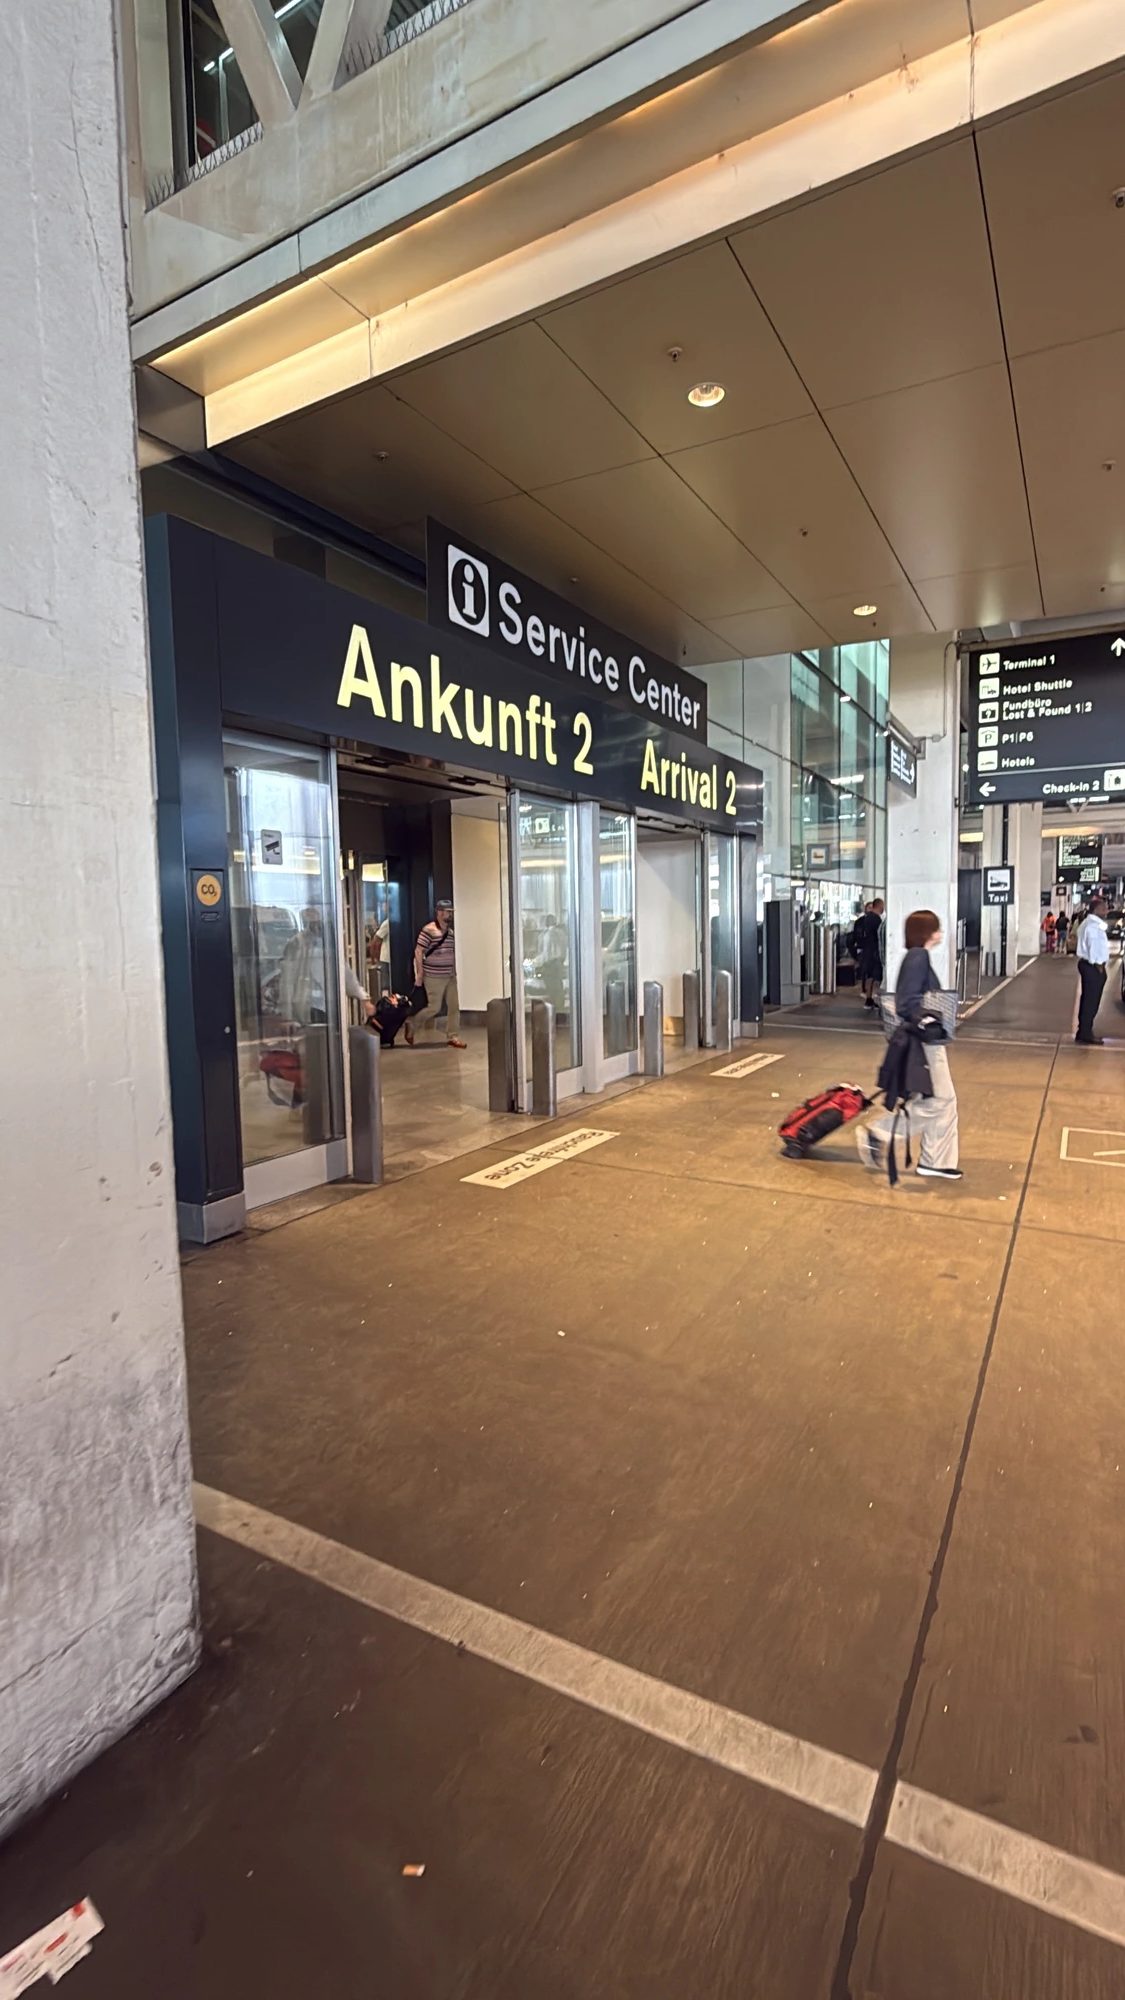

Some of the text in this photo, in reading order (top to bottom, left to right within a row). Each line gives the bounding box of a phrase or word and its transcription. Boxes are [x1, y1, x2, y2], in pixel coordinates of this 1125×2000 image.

[499, 582, 619, 692] Service
[629, 655, 701, 730] Center
[1003, 655, 1055, 671] Terminal 1
[1003, 678, 1072, 695] Hotel Shuttle
[336, 624, 594, 776] Ankunft 2
[1003, 698, 1052, 712] Fundbüro
[1003, 710, 1024, 721] Lost
[1027, 709, 1035, 718] &
[1039, 703, 1071, 717] Found
[1002, 756, 1035, 768] Hotels
[640, 738, 737, 815] Arrival 2
[1043, 780, 1100, 794] Check-in 2
[988, 893, 1008, 902] Taxi
[484, 1161, 535, 1181] Zone
